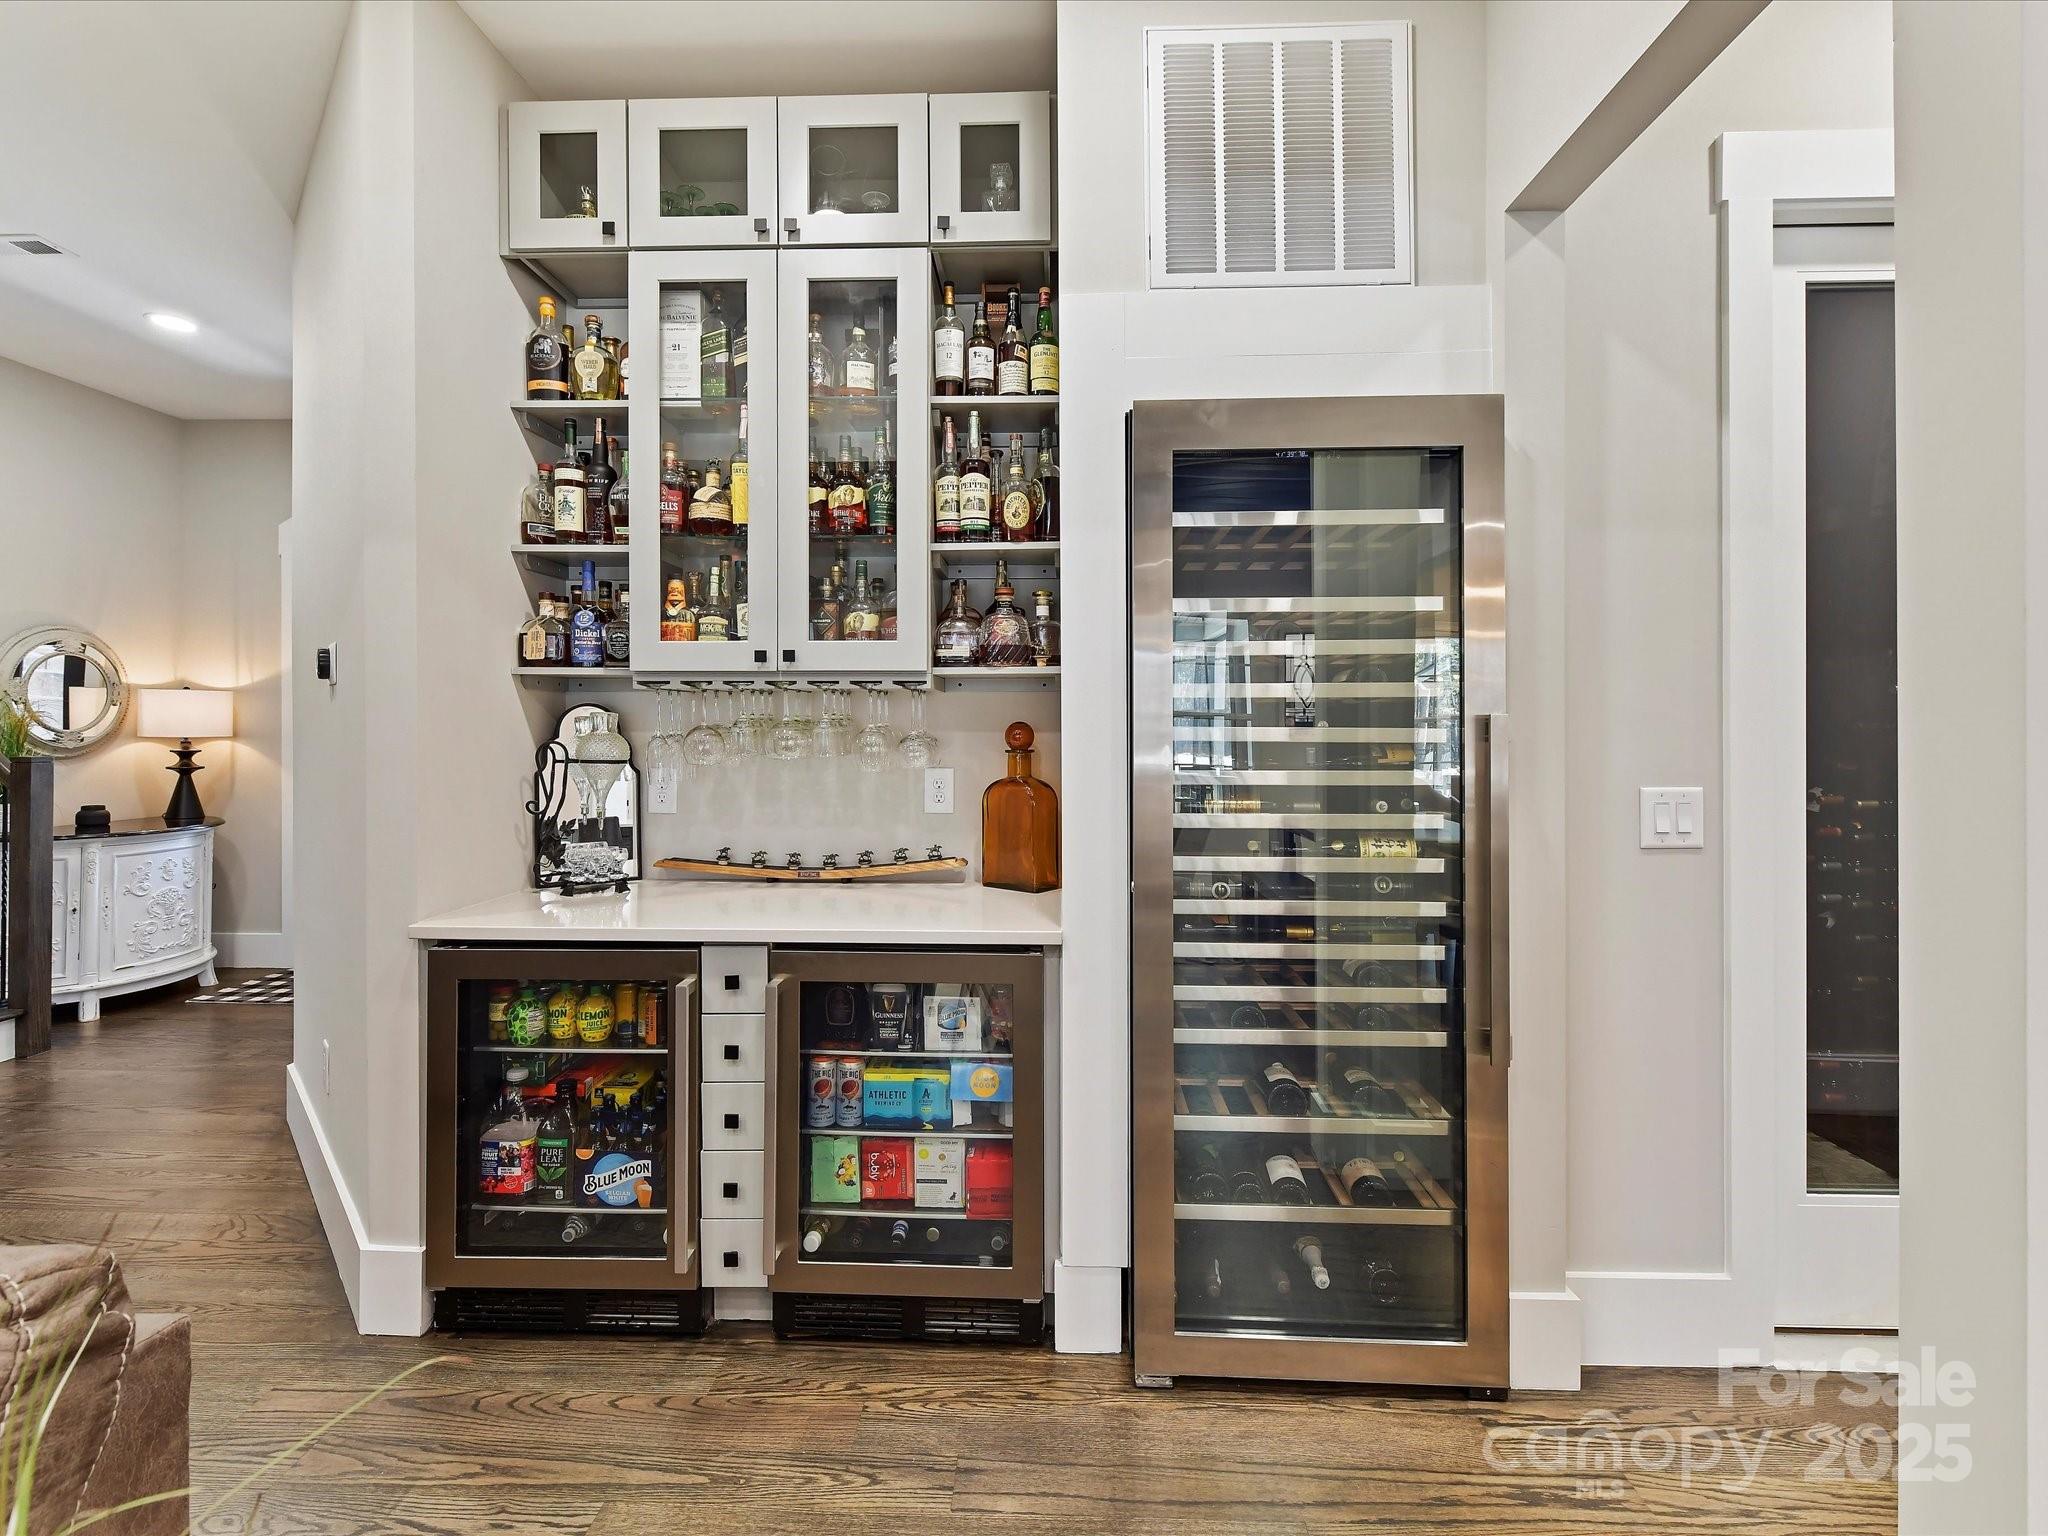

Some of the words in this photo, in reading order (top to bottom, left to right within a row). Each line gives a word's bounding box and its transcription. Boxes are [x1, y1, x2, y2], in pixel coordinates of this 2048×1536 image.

[960, 482, 989, 490] PEPPER
[660, 501, 679, 511] ELL'S
[574, 628, 600, 638] Dickel
[580, 1009, 610, 1021] LEMON
[586, 1020, 603, 1028] JUICE
[812, 1070, 822, 1078] THE
[840, 1070, 848, 1078] THE
[868, 1090, 907, 1099] ATHLETIC
[541, 1148, 564, 1156] PURE
[540, 1155, 564, 1163] LEAF
[584, 1172, 617, 1193] BLUE
[618, 1162, 650, 1180] MOON
